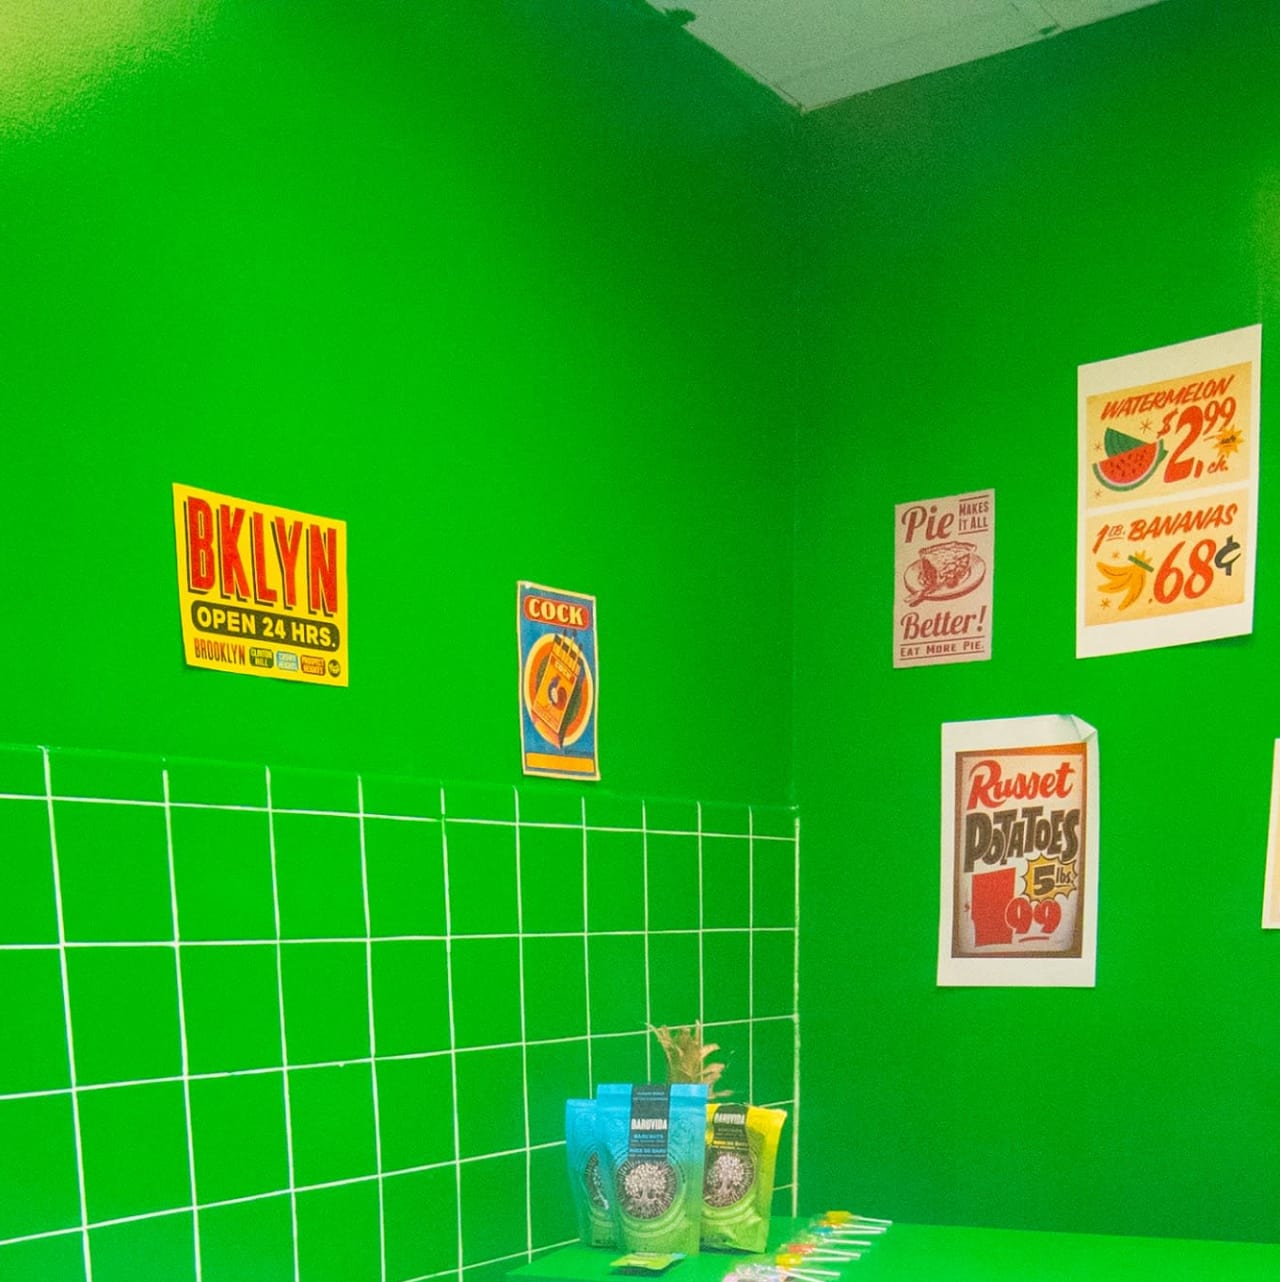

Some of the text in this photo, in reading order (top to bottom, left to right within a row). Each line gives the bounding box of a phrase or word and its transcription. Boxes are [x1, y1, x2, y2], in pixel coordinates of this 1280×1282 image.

[1100, 374, 1235, 420] WATERMELON
[901, 504, 955, 543] Pie
[958, 514, 989, 531] IT ALL
[959, 500, 989, 515] MAKES
[1127, 503, 1238, 542] BANANAS
[184, 495, 338, 618] BKLYN
[196, 605, 337, 648] OPEN 24 HRS.
[528, 598, 585, 626] COCK
[900, 605, 987, 640] Better!
[194, 637, 246, 665] BROOKLYN
[900, 646, 920, 657] EAT
[926, 641, 956, 654] MORE
[967, 759, 1075, 811] Russet
[964, 806, 1081, 874] POTATOES
[1033, 864, 1056, 896] 5
